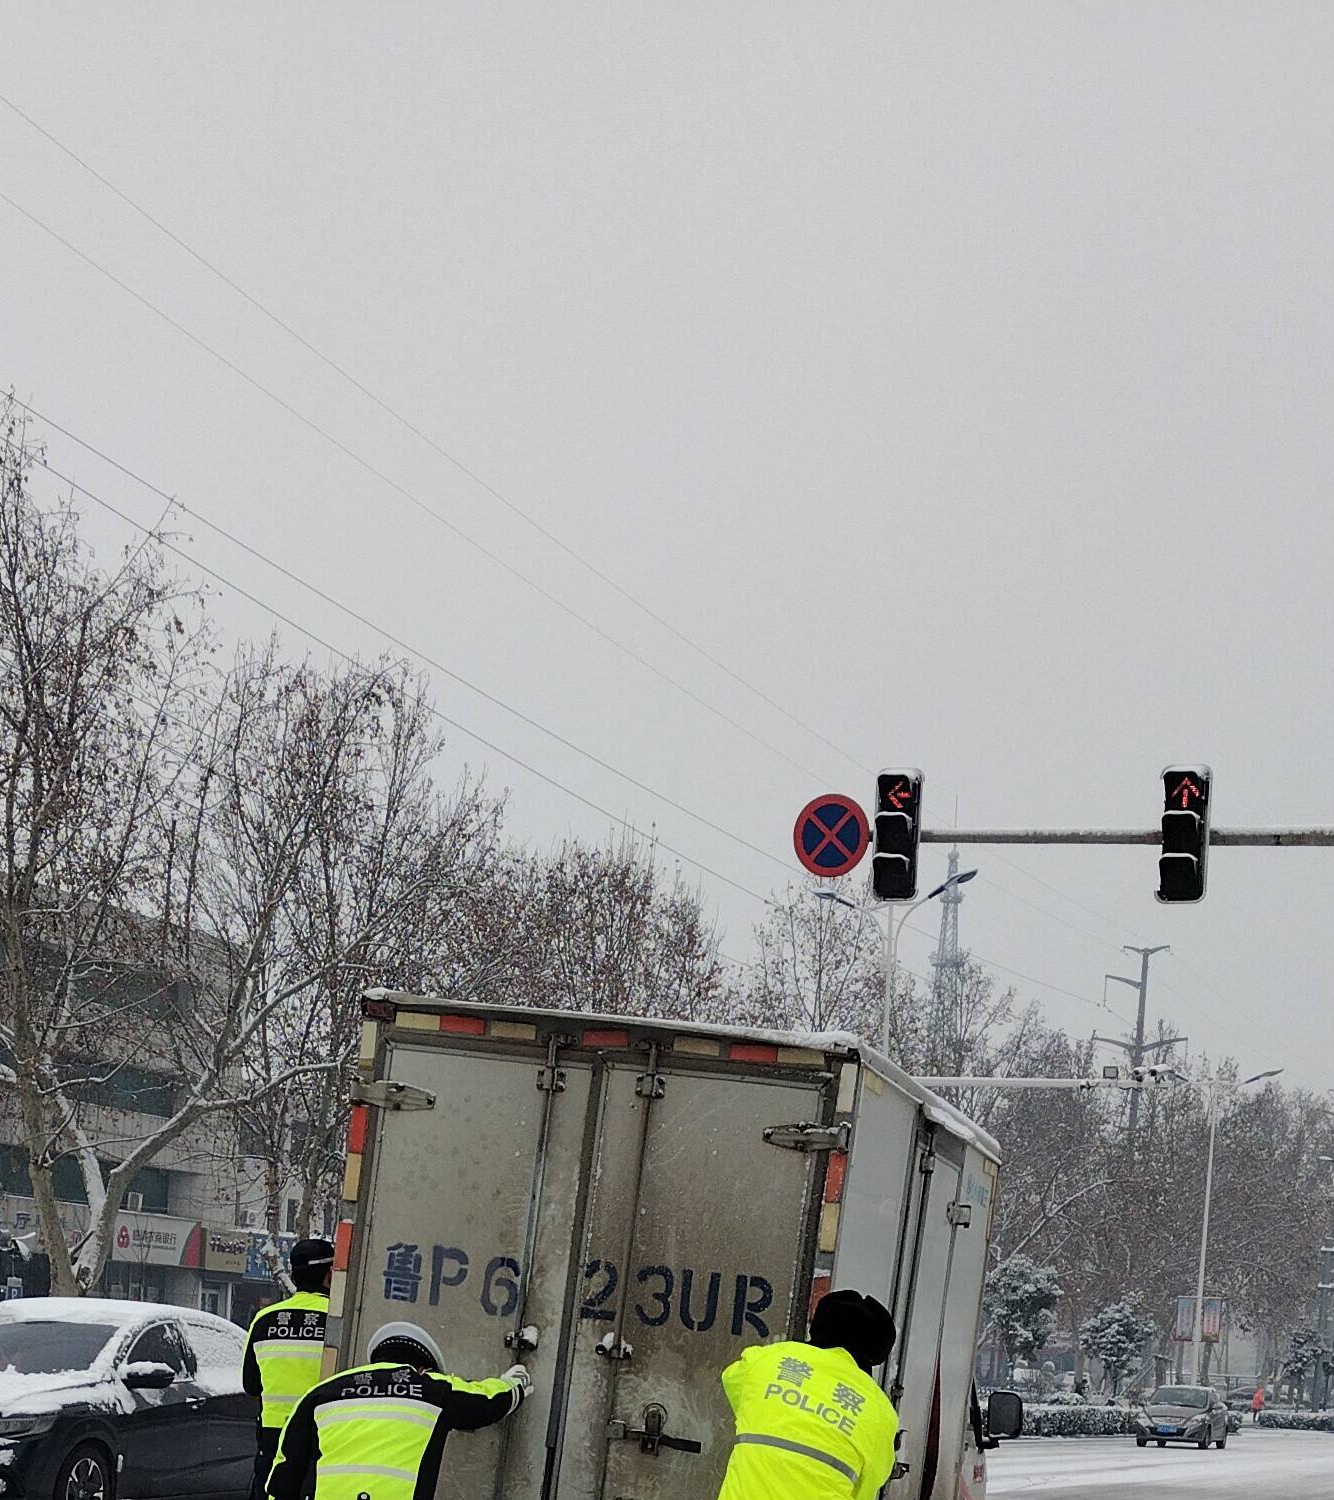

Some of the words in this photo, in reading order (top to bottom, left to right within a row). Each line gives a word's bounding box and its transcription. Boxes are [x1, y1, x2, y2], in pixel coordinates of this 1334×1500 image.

[277, 1311, 318, 1326] 警察
[267, 1326, 324, 1338] POLICE
[353, 1369, 411, 1385] 警察
[341, 1384, 423, 1398] POLICE
[776, 1356, 867, 1418] 警察
[764, 1383, 857, 1437] POLICE
